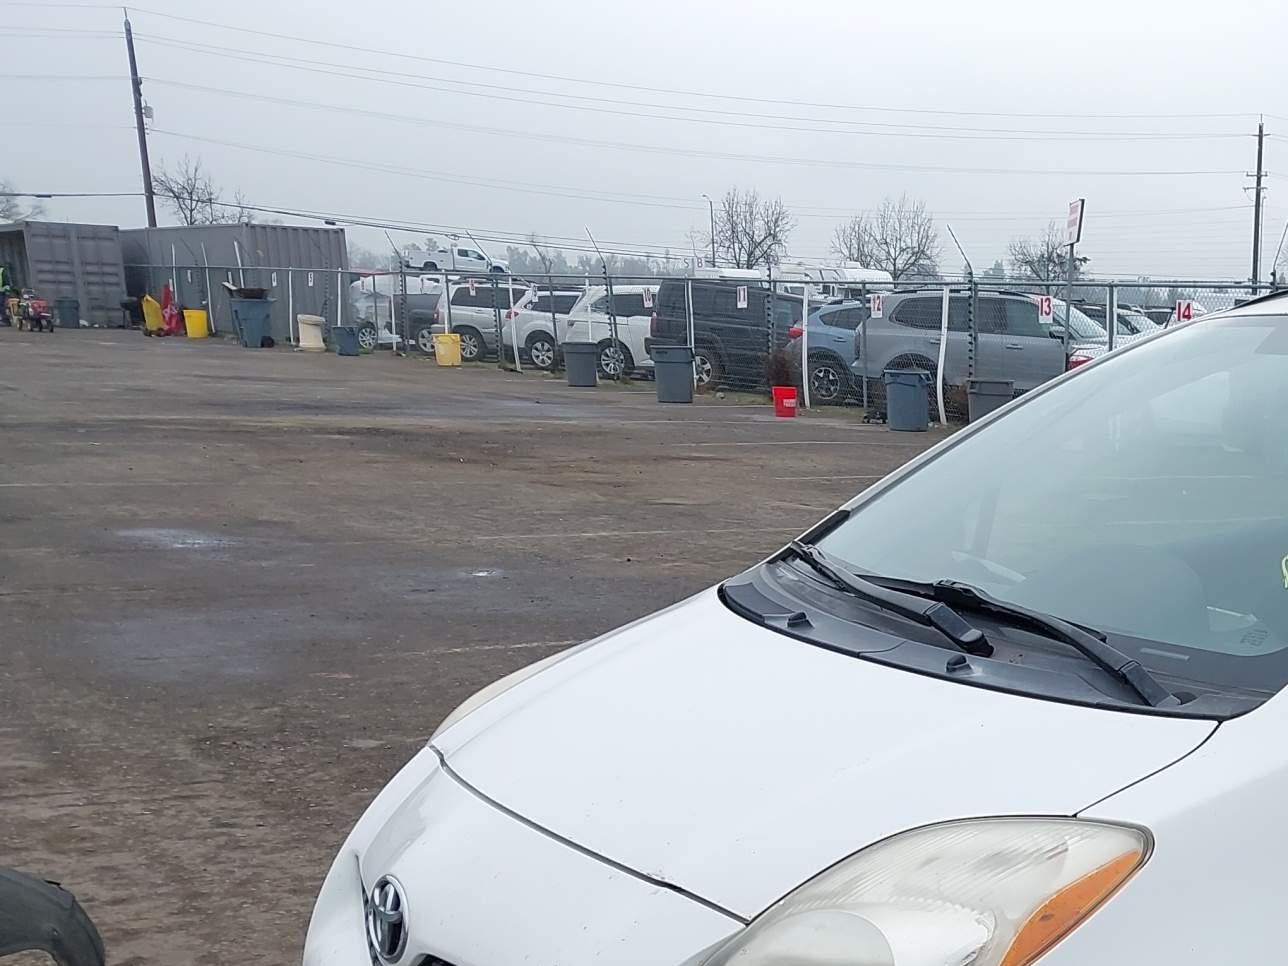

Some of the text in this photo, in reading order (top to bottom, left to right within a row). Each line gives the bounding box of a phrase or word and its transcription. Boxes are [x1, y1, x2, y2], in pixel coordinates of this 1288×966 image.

[872, 295, 881, 311] 12
[1040, 297, 1051, 316] 13
[1177, 301, 1192, 321] 14
